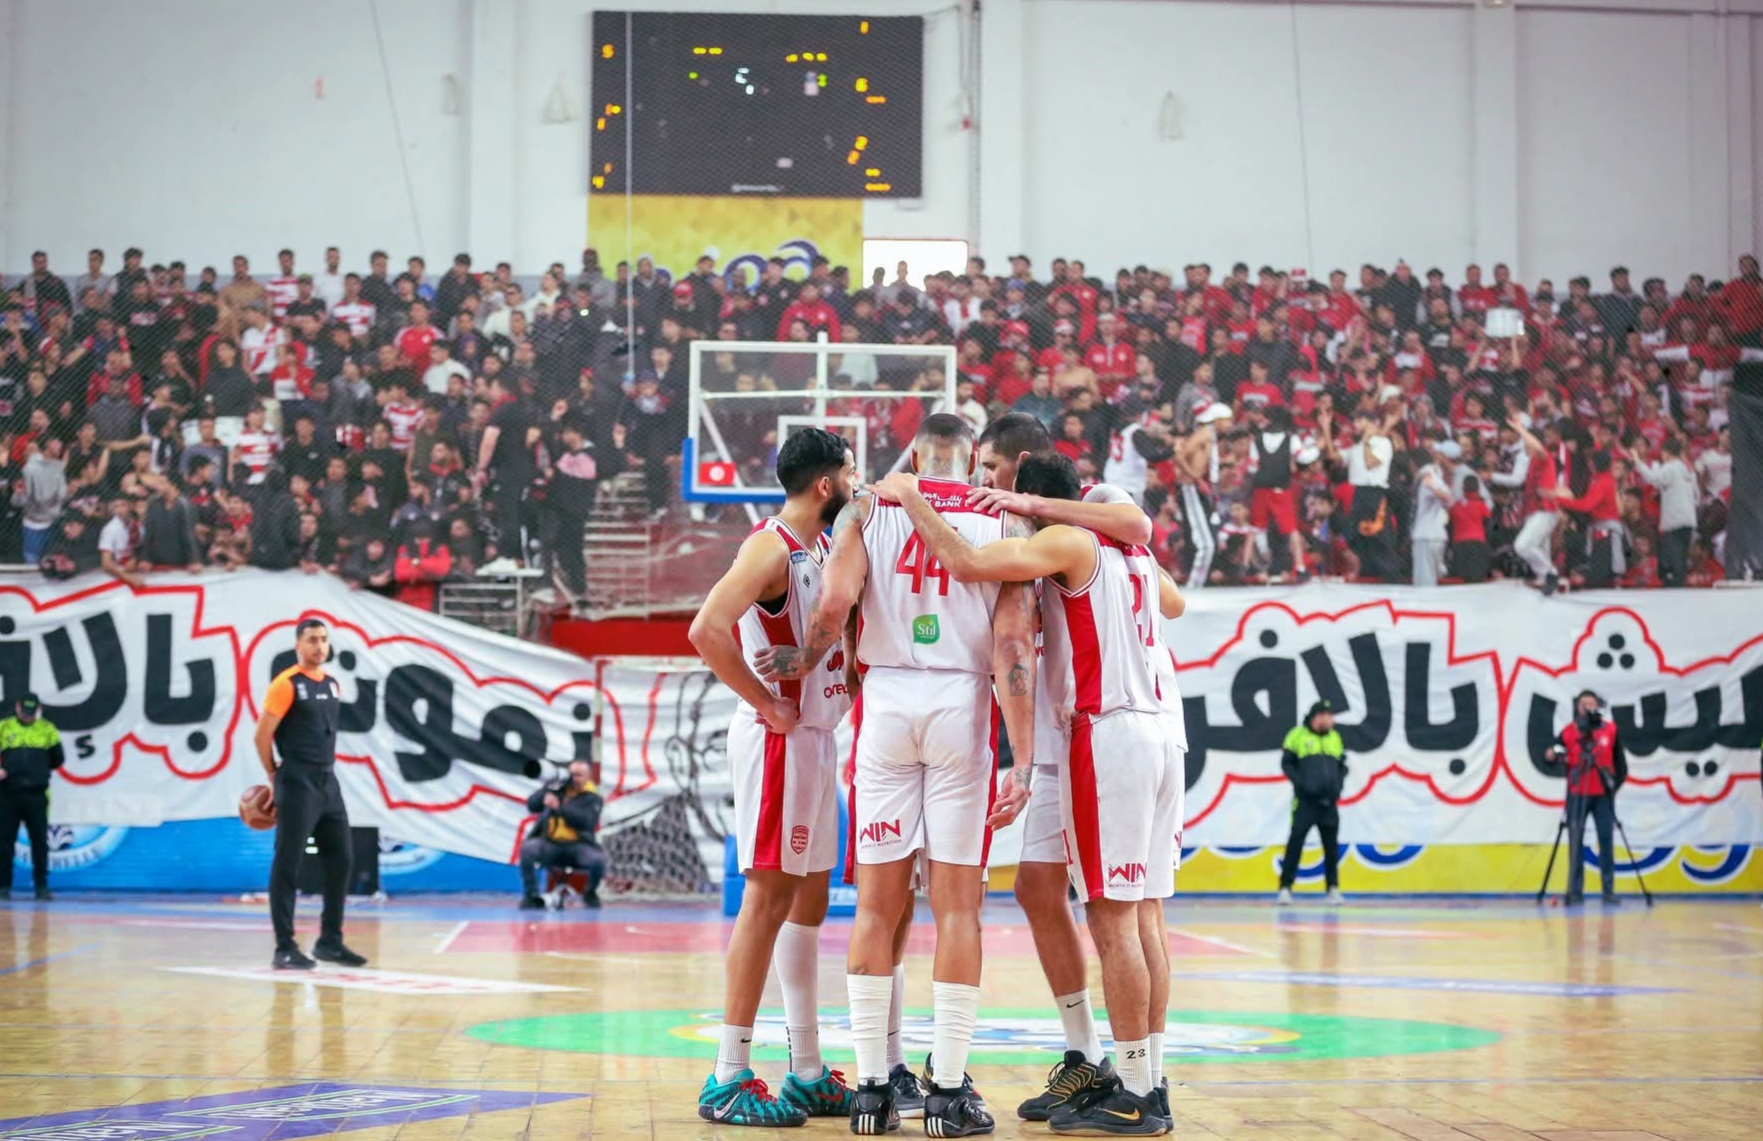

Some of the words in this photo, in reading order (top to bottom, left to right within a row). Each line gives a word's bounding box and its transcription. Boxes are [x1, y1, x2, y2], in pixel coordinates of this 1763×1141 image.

[934, 500, 961, 508] BANK
[917, 622, 936, 636] Stil
[1108, 862, 1148, 883] WIN
[1126, 1048, 1146, 1059] 23
